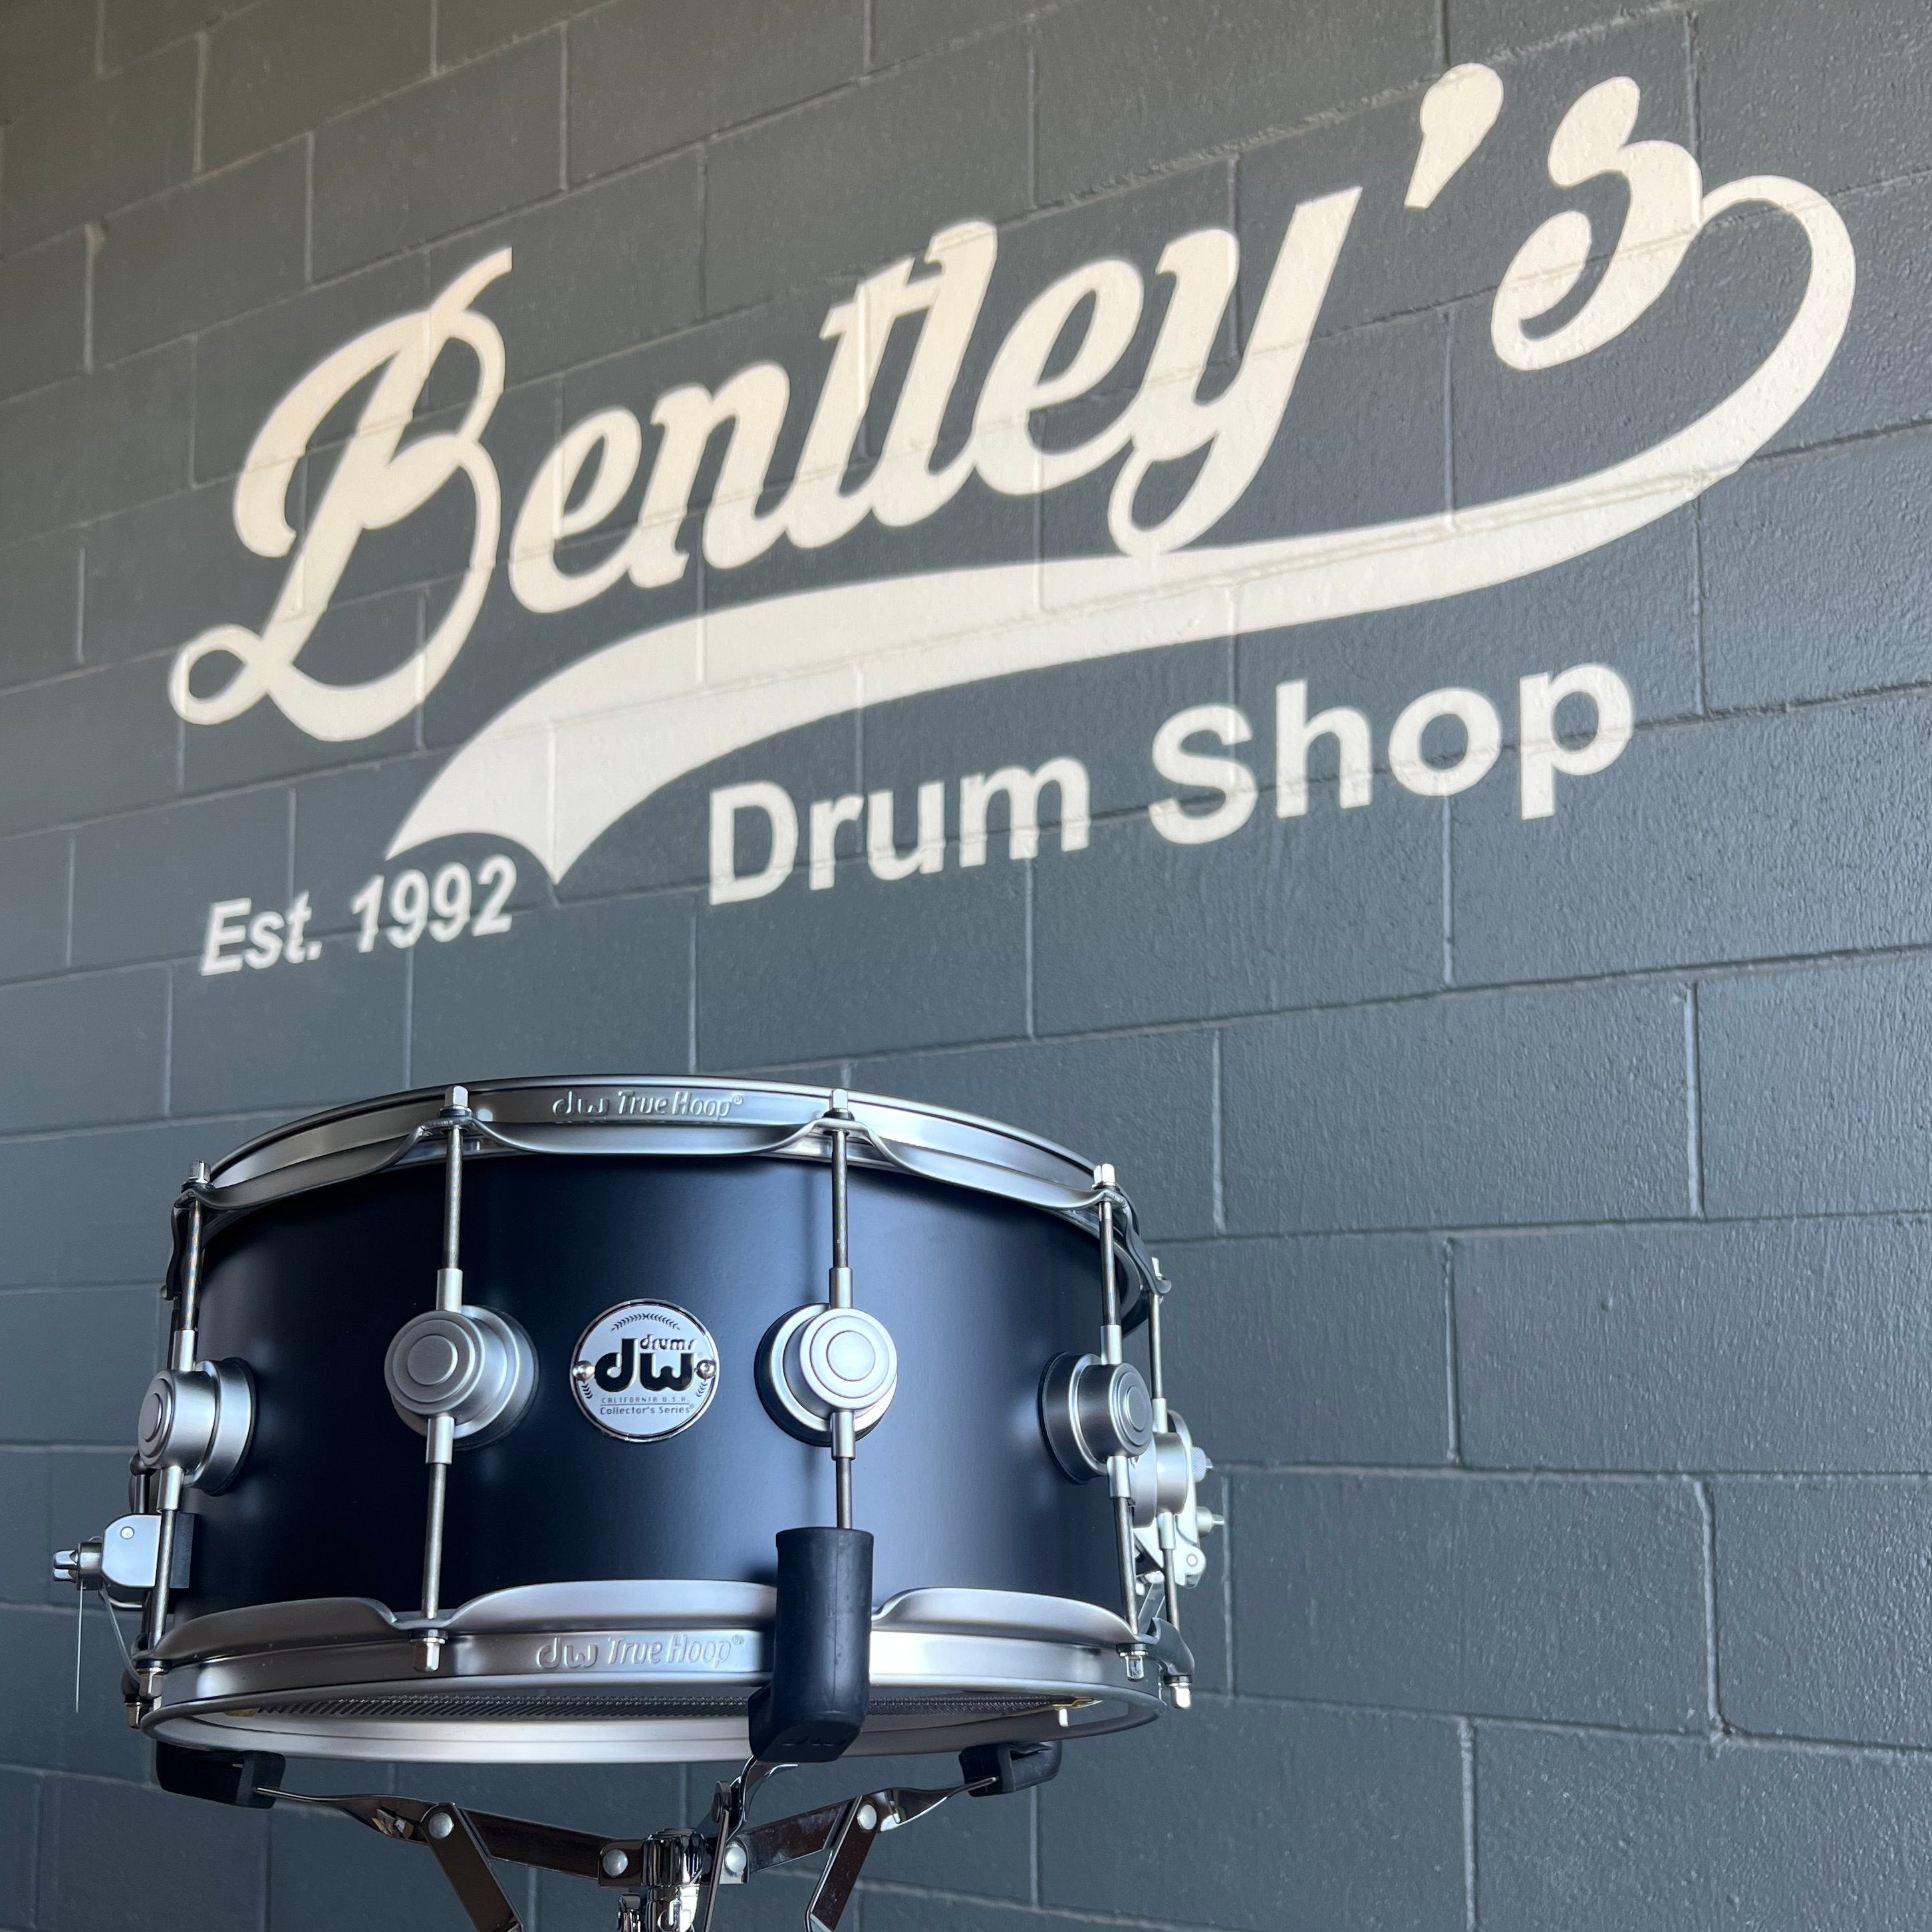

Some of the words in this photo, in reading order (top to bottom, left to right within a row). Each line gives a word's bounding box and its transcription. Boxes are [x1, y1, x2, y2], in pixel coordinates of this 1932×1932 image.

[169, 63, 1729, 742] Bentley's
[708, 757, 1091, 906] Drum
[1149, 661, 1637, 845] Shop
[200, 891, 323, 976] Est.
[350, 854, 517, 954] 1992
[595, 1337, 695, 1393] dw
[600, 1406, 656, 1415] Collector's
